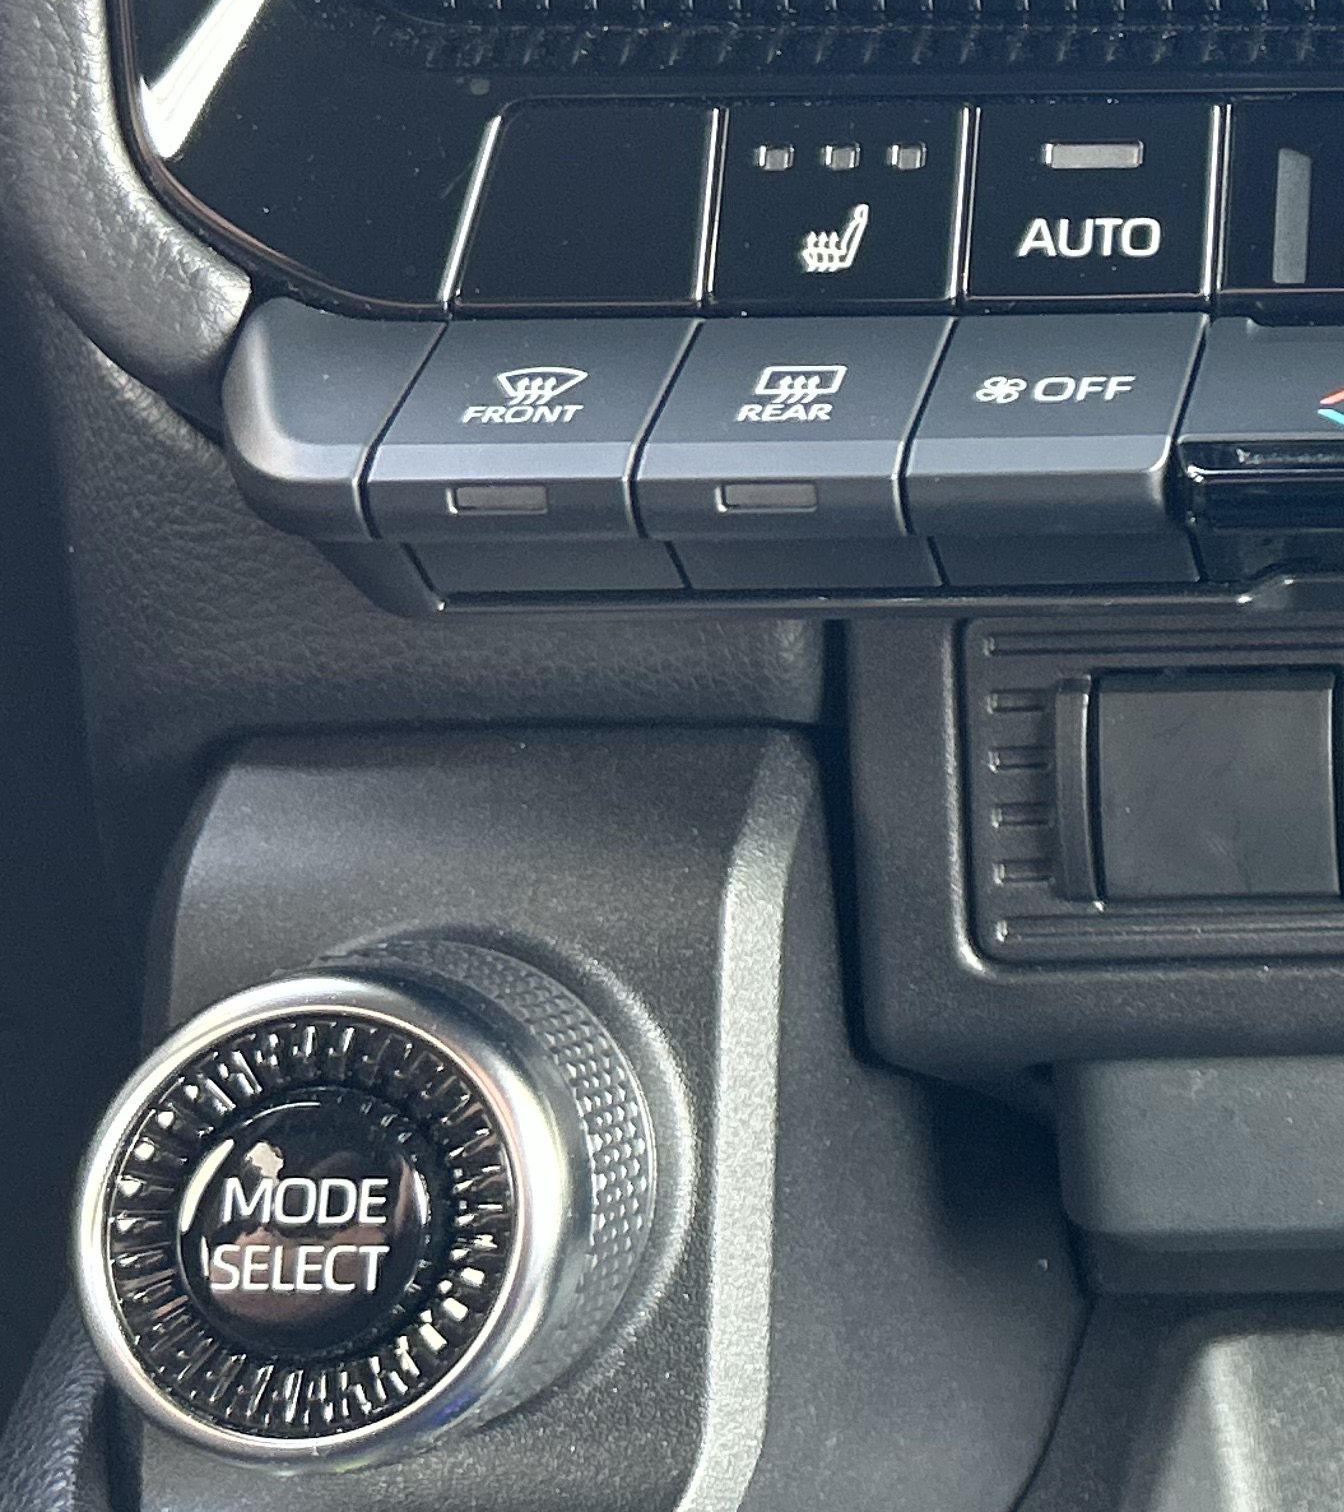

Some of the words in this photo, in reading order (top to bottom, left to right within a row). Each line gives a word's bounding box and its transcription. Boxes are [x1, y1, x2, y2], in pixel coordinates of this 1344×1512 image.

[1017, 217, 1162, 258] AUTO
[1032, 374, 1137, 402] OFF
[462, 403, 583, 424] FRONT
[736, 402, 833, 423] REAR
[222, 1176, 389, 1226] MODE
[209, 1244, 390, 1291] SELECT
